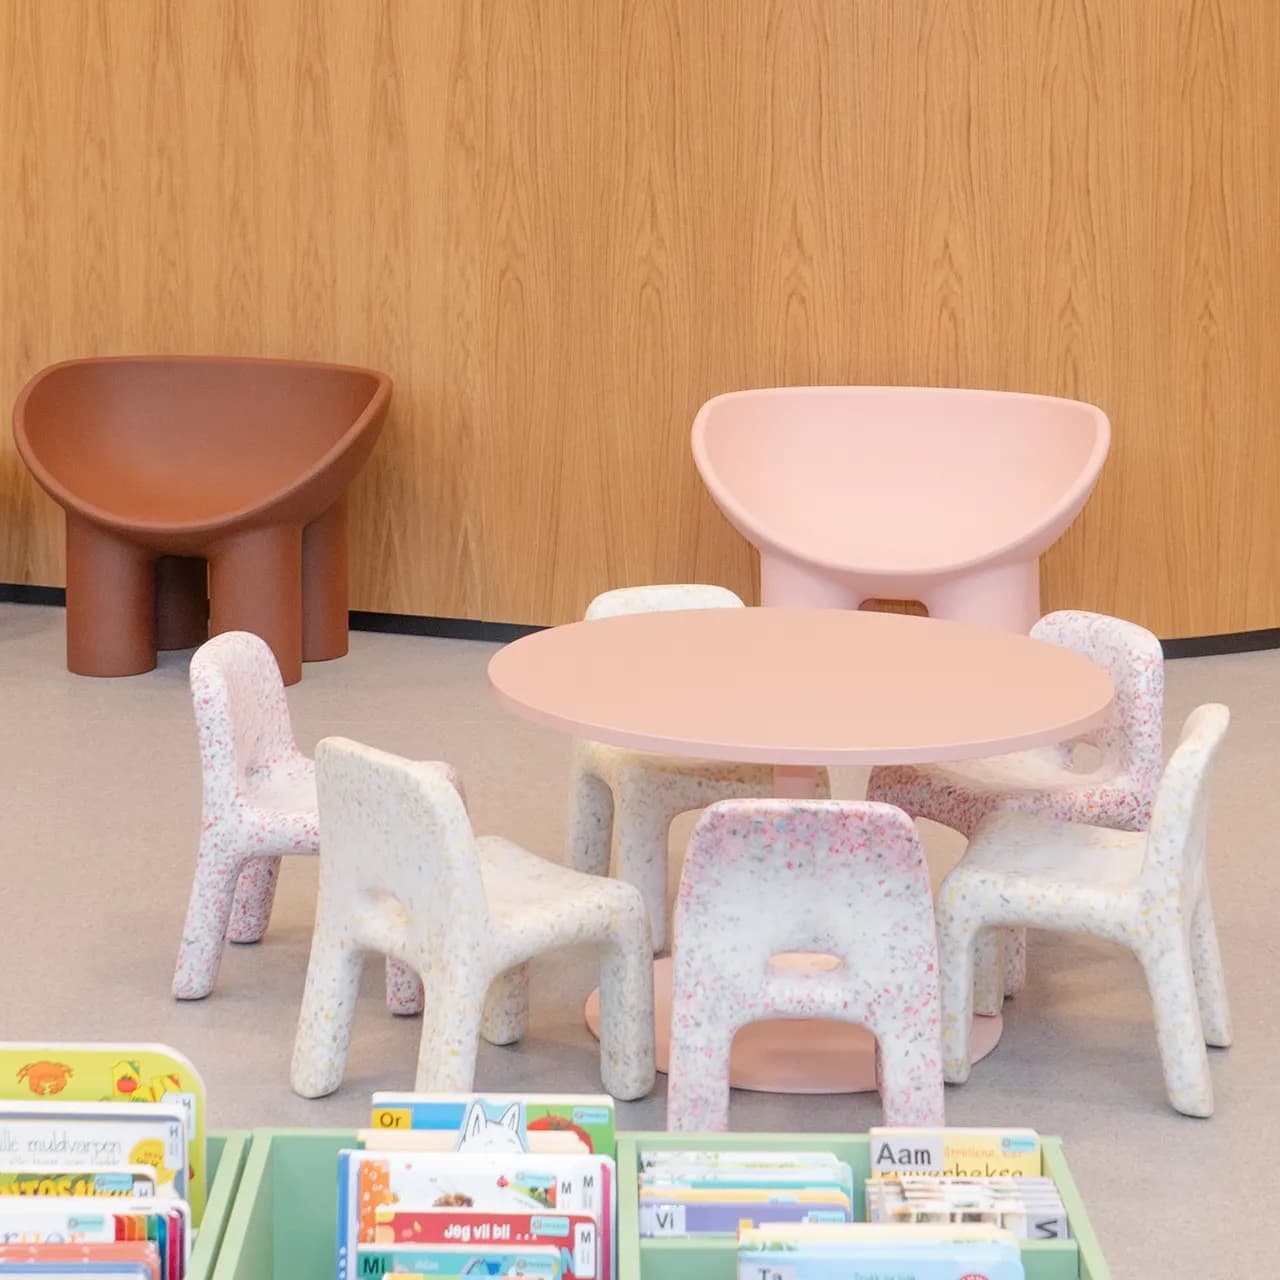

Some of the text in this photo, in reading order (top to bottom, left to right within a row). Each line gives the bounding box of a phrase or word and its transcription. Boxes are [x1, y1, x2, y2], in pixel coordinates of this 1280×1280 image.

[379, 1112, 403, 1129] Or
[26, 1129, 122, 1158] muldvarpen
[876, 1141, 932, 1166] Aam
[561, 1182, 572, 1194] M
[583, 1175, 594, 1188] M
[655, 1211, 675, 1230] Vi
[444, 1223, 471, 1241] Jeg
[473, 1223, 491, 1239] vil
[493, 1223, 511, 1239] bli
[580, 1231, 591, 1244] M
[363, 1256, 386, 1274] Mi
